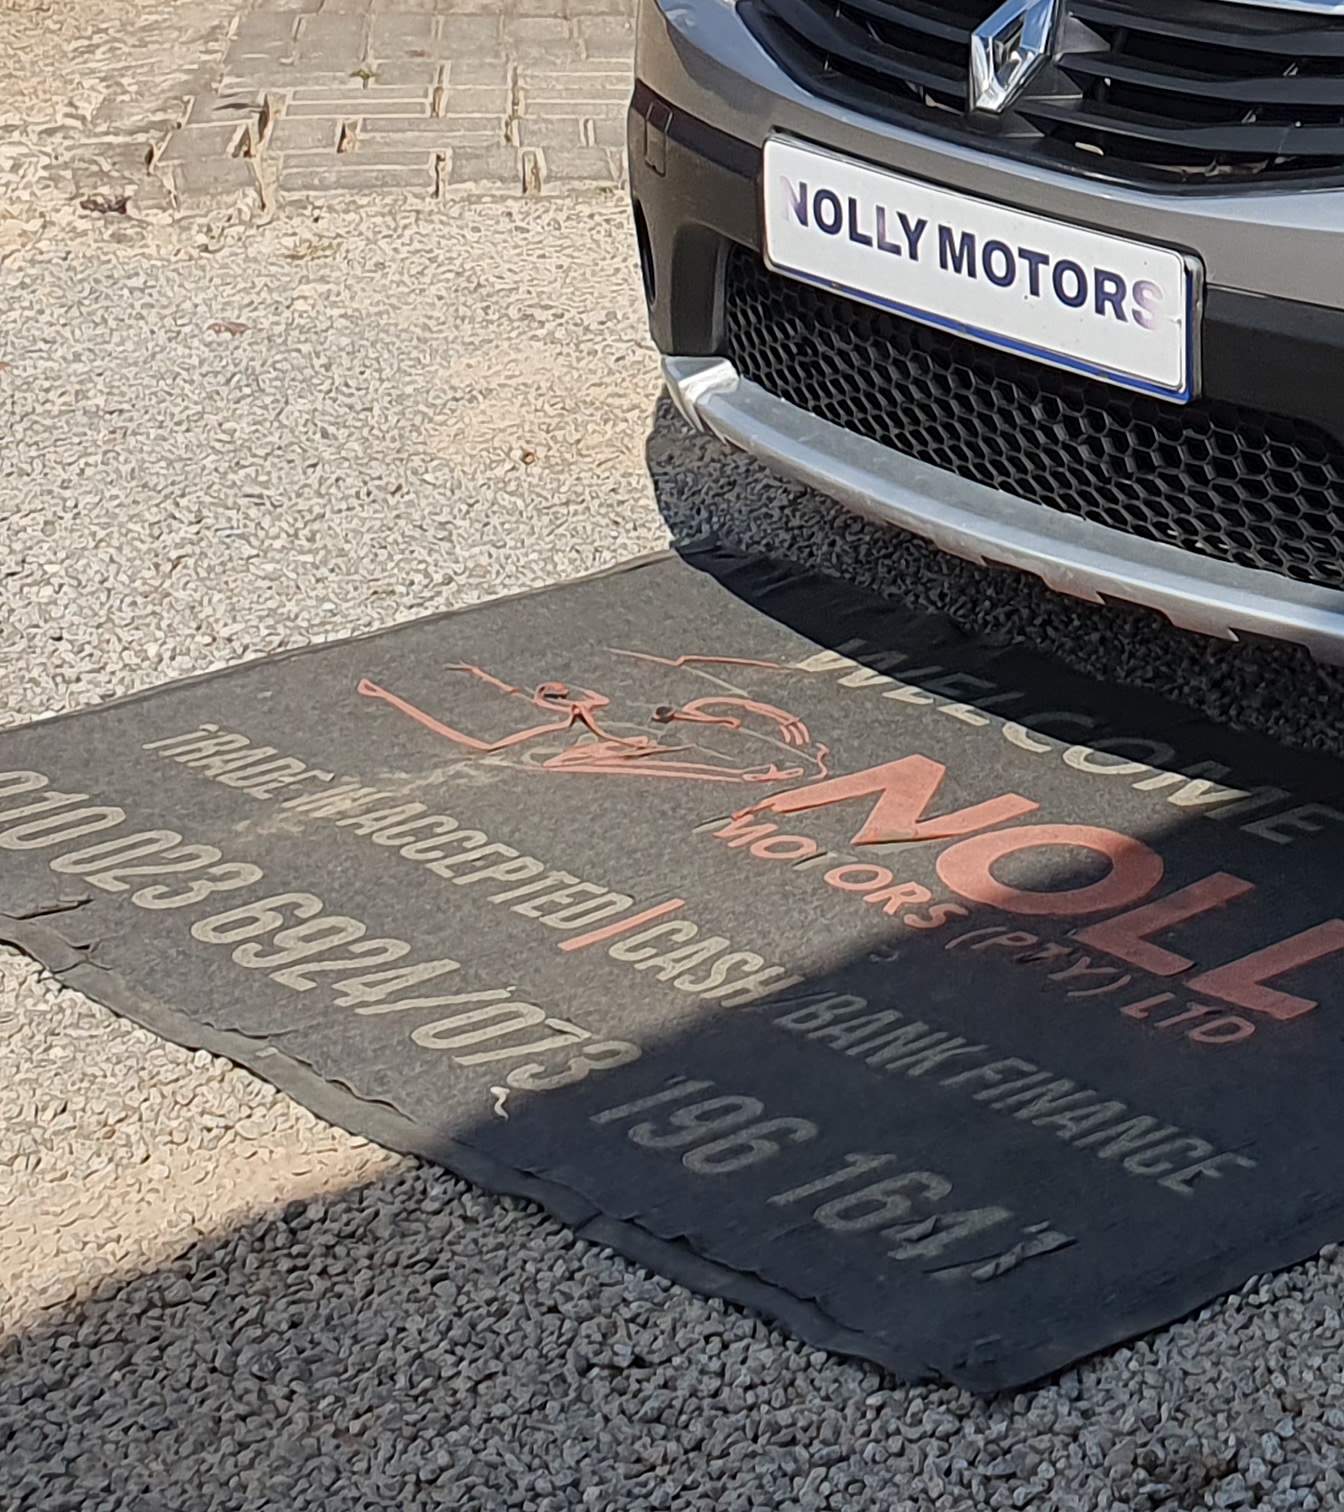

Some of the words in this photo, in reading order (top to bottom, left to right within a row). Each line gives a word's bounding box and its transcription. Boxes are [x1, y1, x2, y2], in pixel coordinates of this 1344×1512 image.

[779, 175, 928, 262] NOLLY
[938, 225, 1165, 330] MOTORS
[50, 829, 263, 909] 023
[589, 1075, 818, 1174] 196
[142, 723, 335, 800] TRADE
[938, 1056, 1257, 1197] FINANCE
[1119, 991, 1257, 1045] LTD
